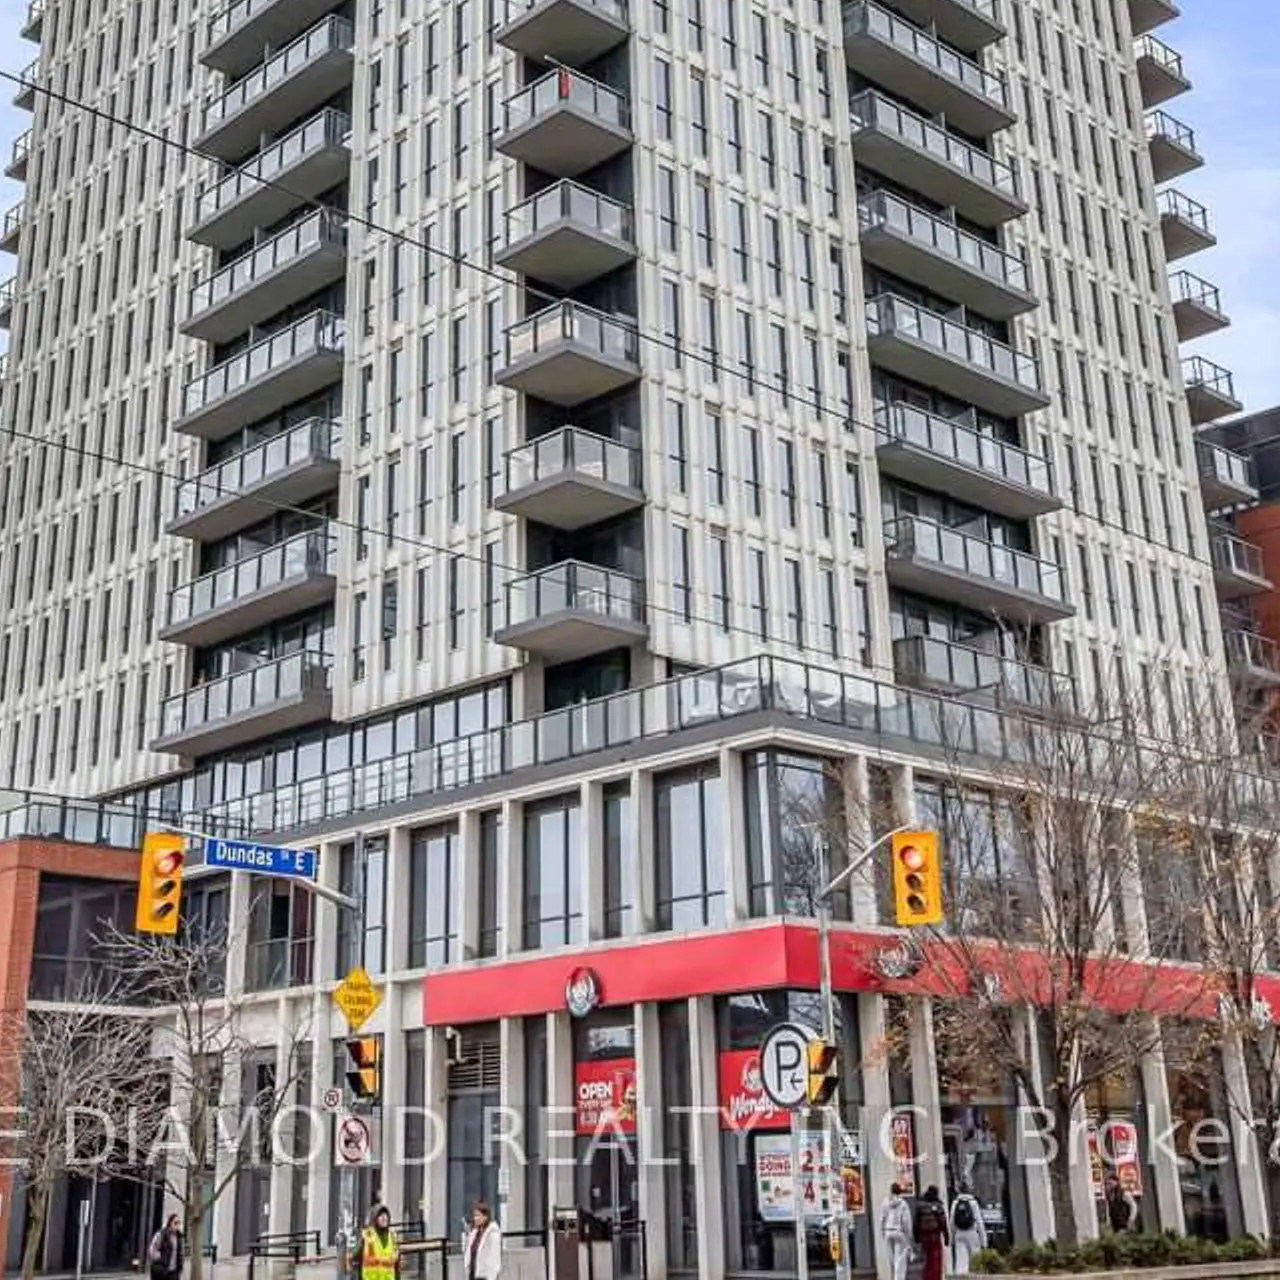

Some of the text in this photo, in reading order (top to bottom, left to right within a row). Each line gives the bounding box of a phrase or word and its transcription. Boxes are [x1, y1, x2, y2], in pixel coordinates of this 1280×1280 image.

[215, 841, 273, 866] Dundas
[295, 851, 306, 871] E
[775, 1040, 802, 1093] P
[579, 1080, 613, 1100] OPEN
[729, 1089, 790, 1122] Wendy
